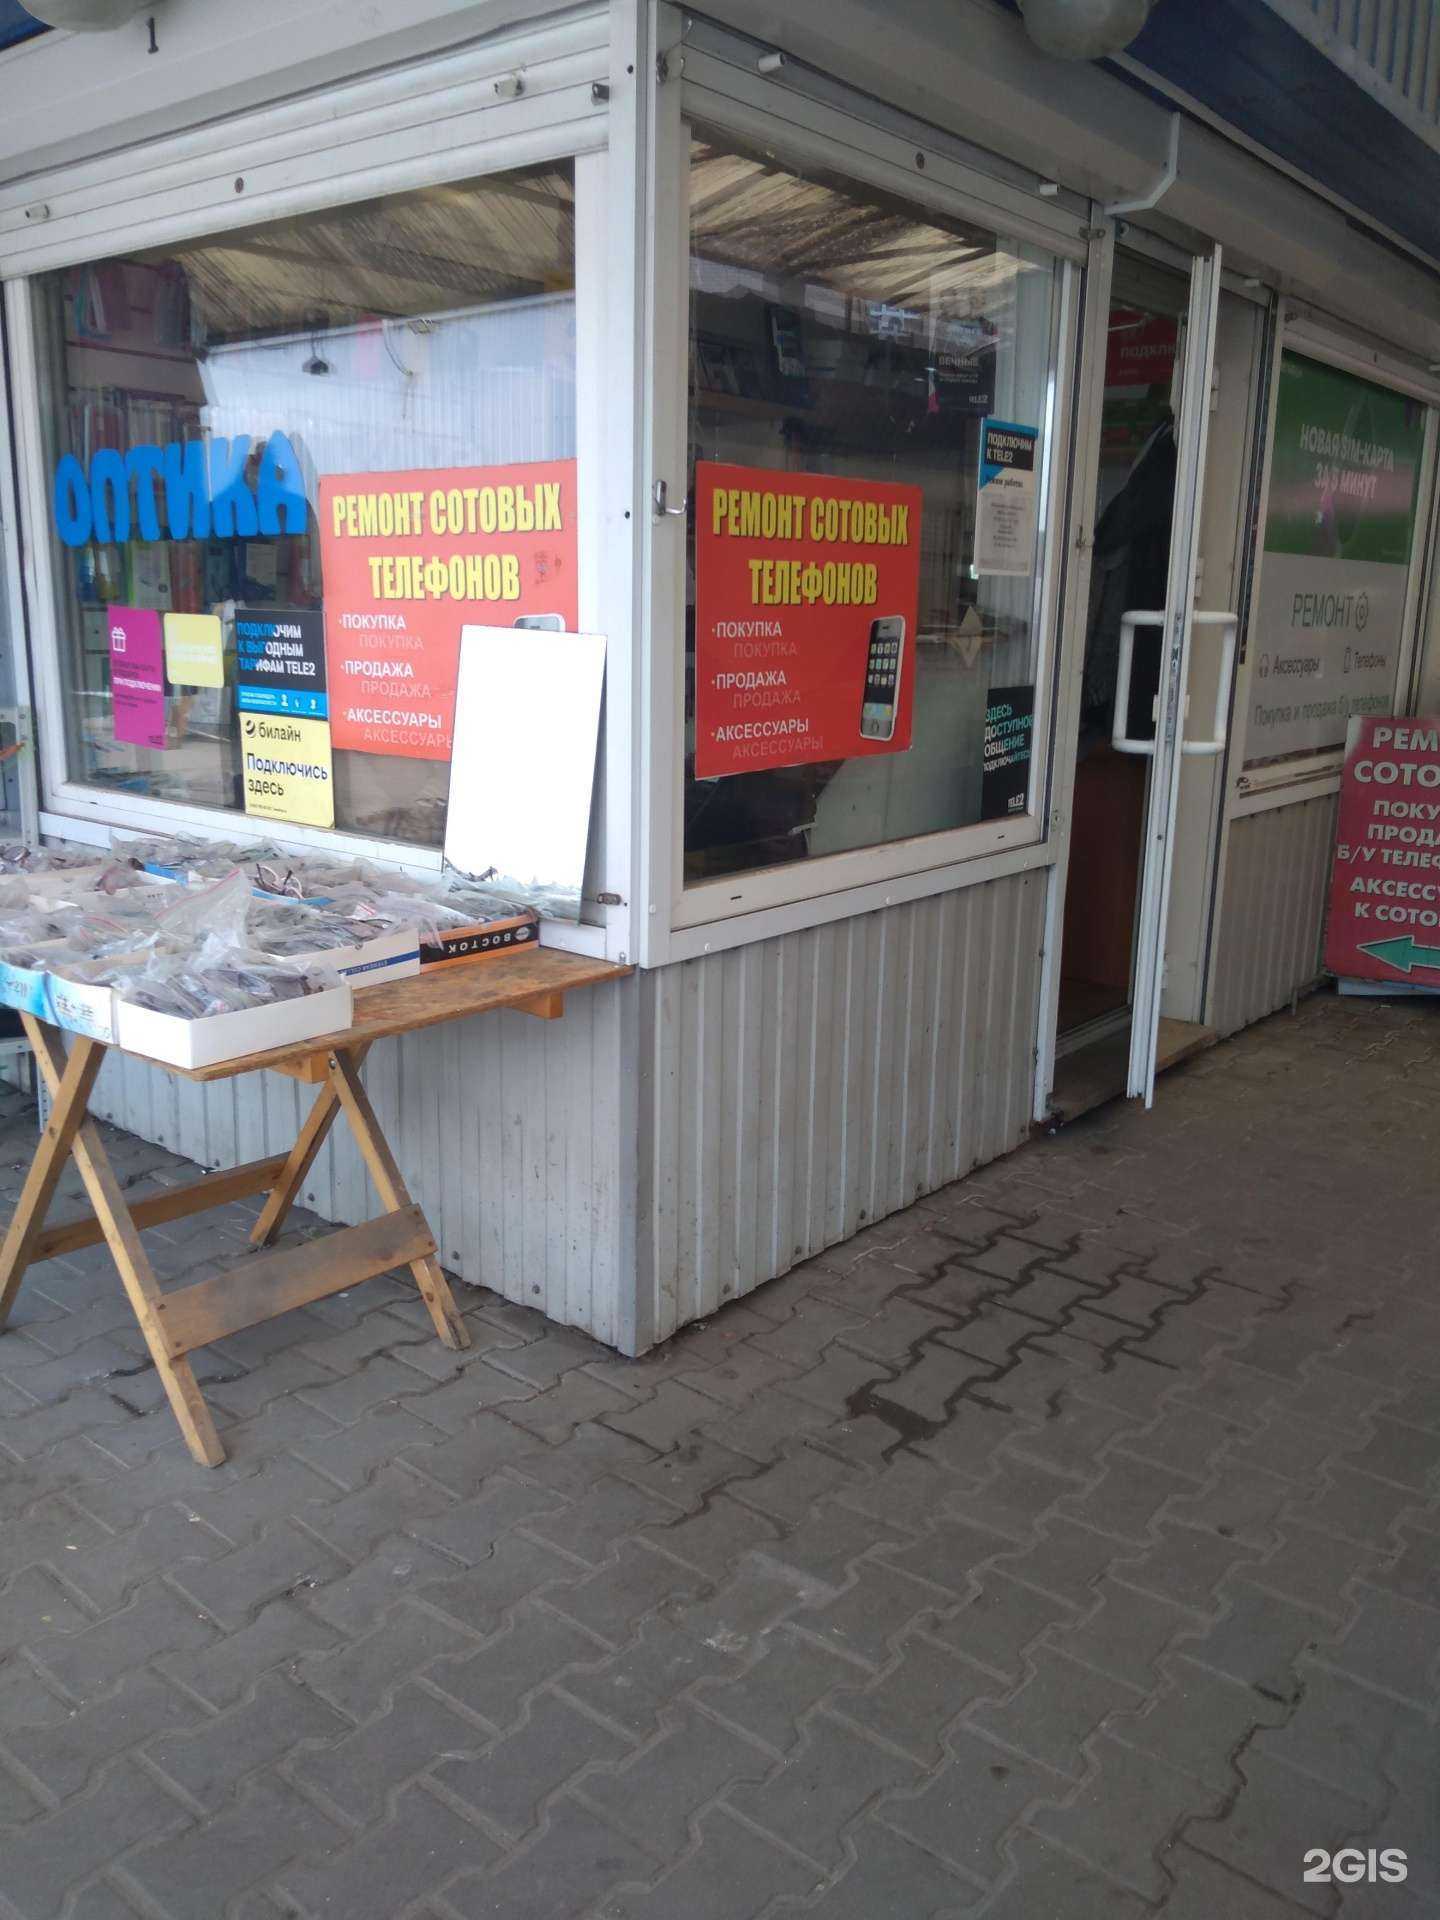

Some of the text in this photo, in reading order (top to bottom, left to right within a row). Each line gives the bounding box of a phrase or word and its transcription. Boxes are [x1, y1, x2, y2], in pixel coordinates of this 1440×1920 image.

[993, 450, 1014, 463] TELE2
[54, 429, 308, 548] ОПТИКА
[332, 482, 562, 537] РЕМОНТ СОТОВЫХ
[712, 488, 909, 545] РЕМОНТ СОТОВЫХ
[367, 554, 521, 601] ТЕЛЕФОНОВ
[748, 559, 878, 606] ТЕЛЕФОНОВ
[1292, 593, 1355, 628] РЕМОНТ
[342, 614, 407, 630] ПОКУПКА
[716, 621, 783, 638] ПОКУПКА
[359, 634, 424, 650] ПОКУПКА
[733, 641, 798, 658] ПОКУПКА
[285, 661, 316, 676] TELE2
[345, 660, 414, 678] ПРОДАЖА
[361, 680, 432, 698] ПРОДАЖА
[716, 670, 787, 690] ПРОДАЖА
[733, 690, 801, 709] ПРОДАЖА
[346, 707, 442, 729] АКСЕССУАРЫ
[258, 721, 301, 742] билайн
[716, 718, 809, 742] АКСЕССУАРЫ
[1373, 726, 1438, 751] РЕМ
[732, 736, 824, 760] АКСЕССУАРЫ
[984, 733, 1025, 758] ОБЩЕНИЕ
[247, 752, 328, 780] Подключись
[1354, 760, 1440, 788] СОТО
[248, 778, 284, 796] здесь
[1337, 844, 1376, 864] Б/У
[1354, 902, 1370, 918] К
[448, 932, 512, 953] ВОСТОК
